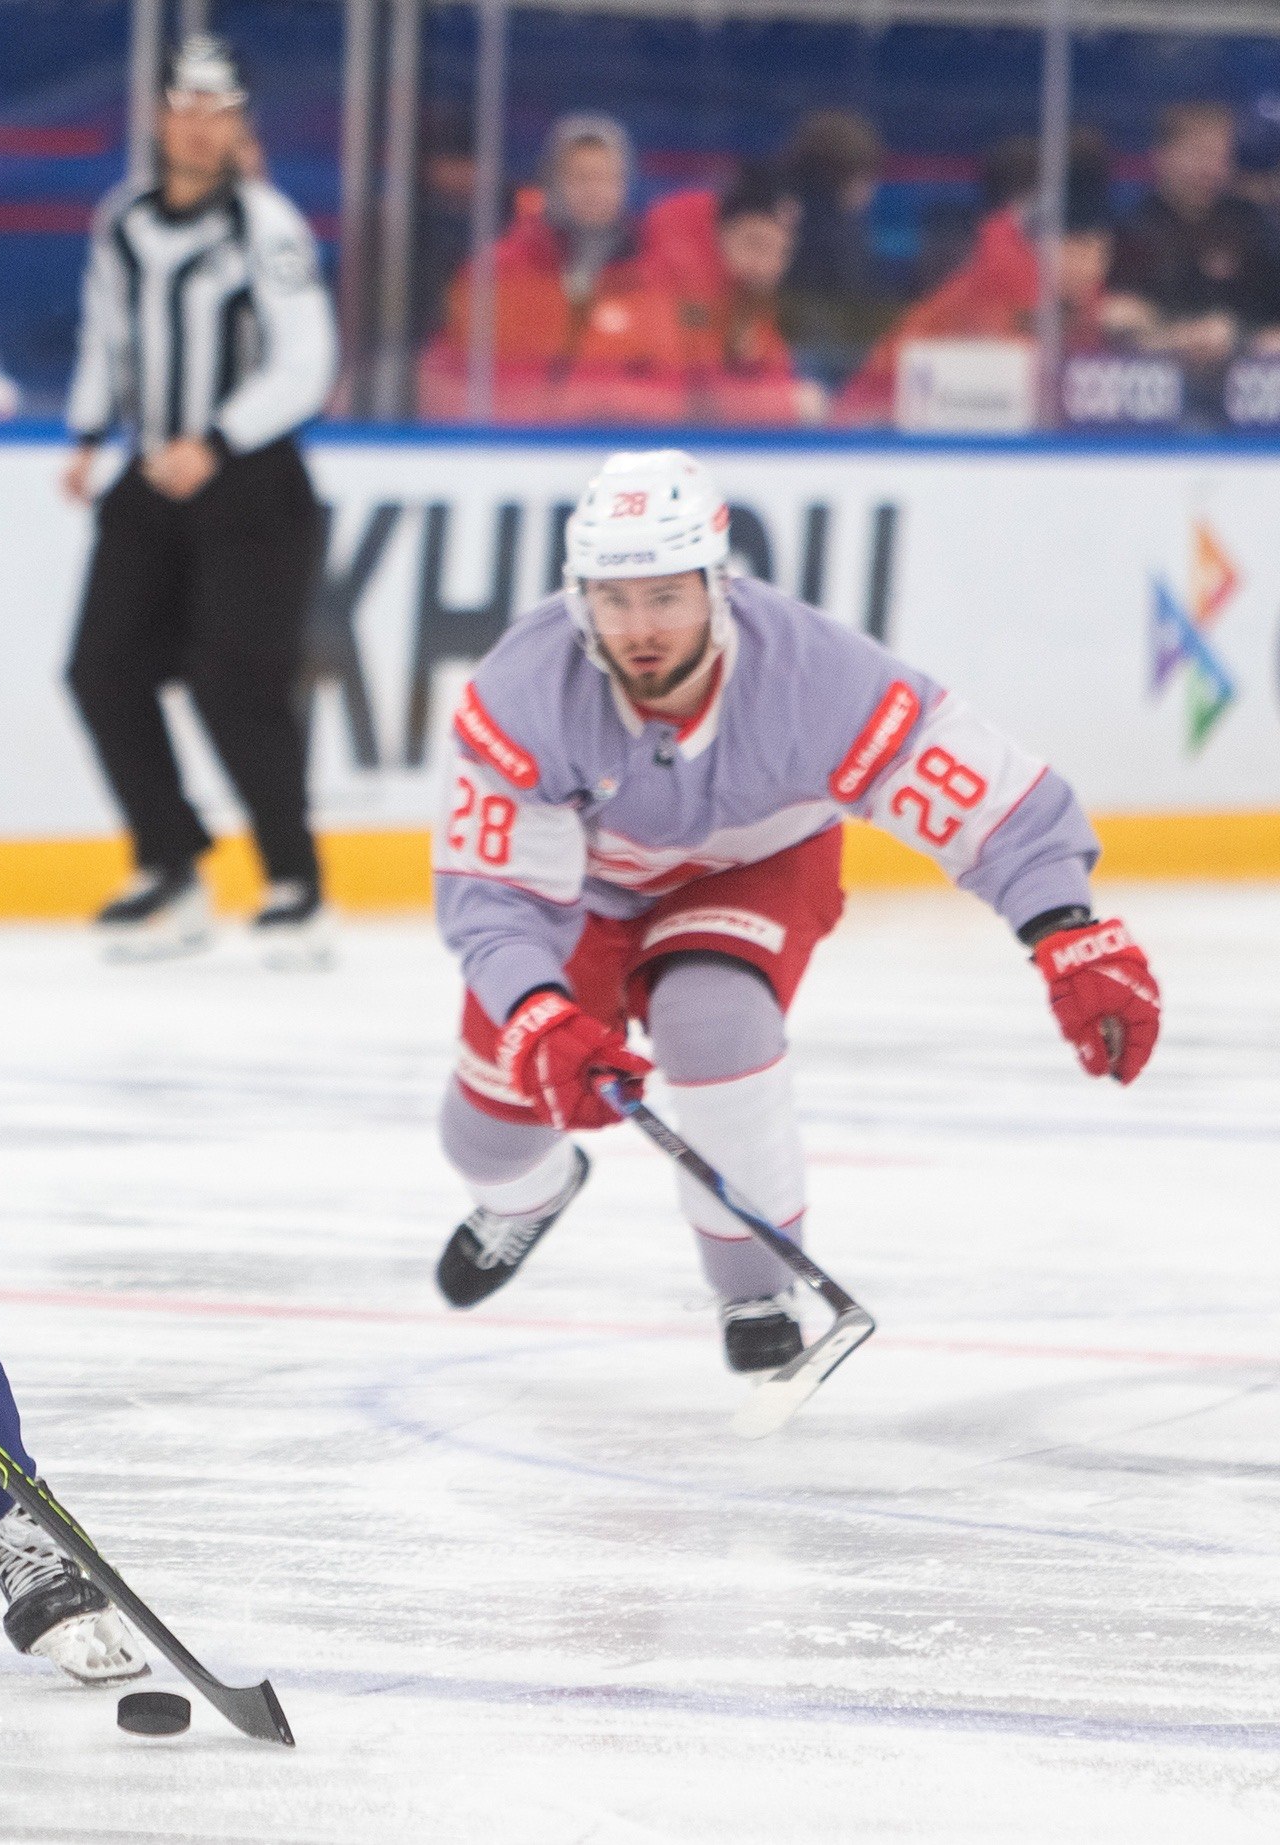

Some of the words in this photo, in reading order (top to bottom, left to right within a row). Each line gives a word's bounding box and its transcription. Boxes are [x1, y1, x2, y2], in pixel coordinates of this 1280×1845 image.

[609, 490, 649, 519] 28
[447, 775, 518, 867] 28
[890, 745, 988, 847] 28
